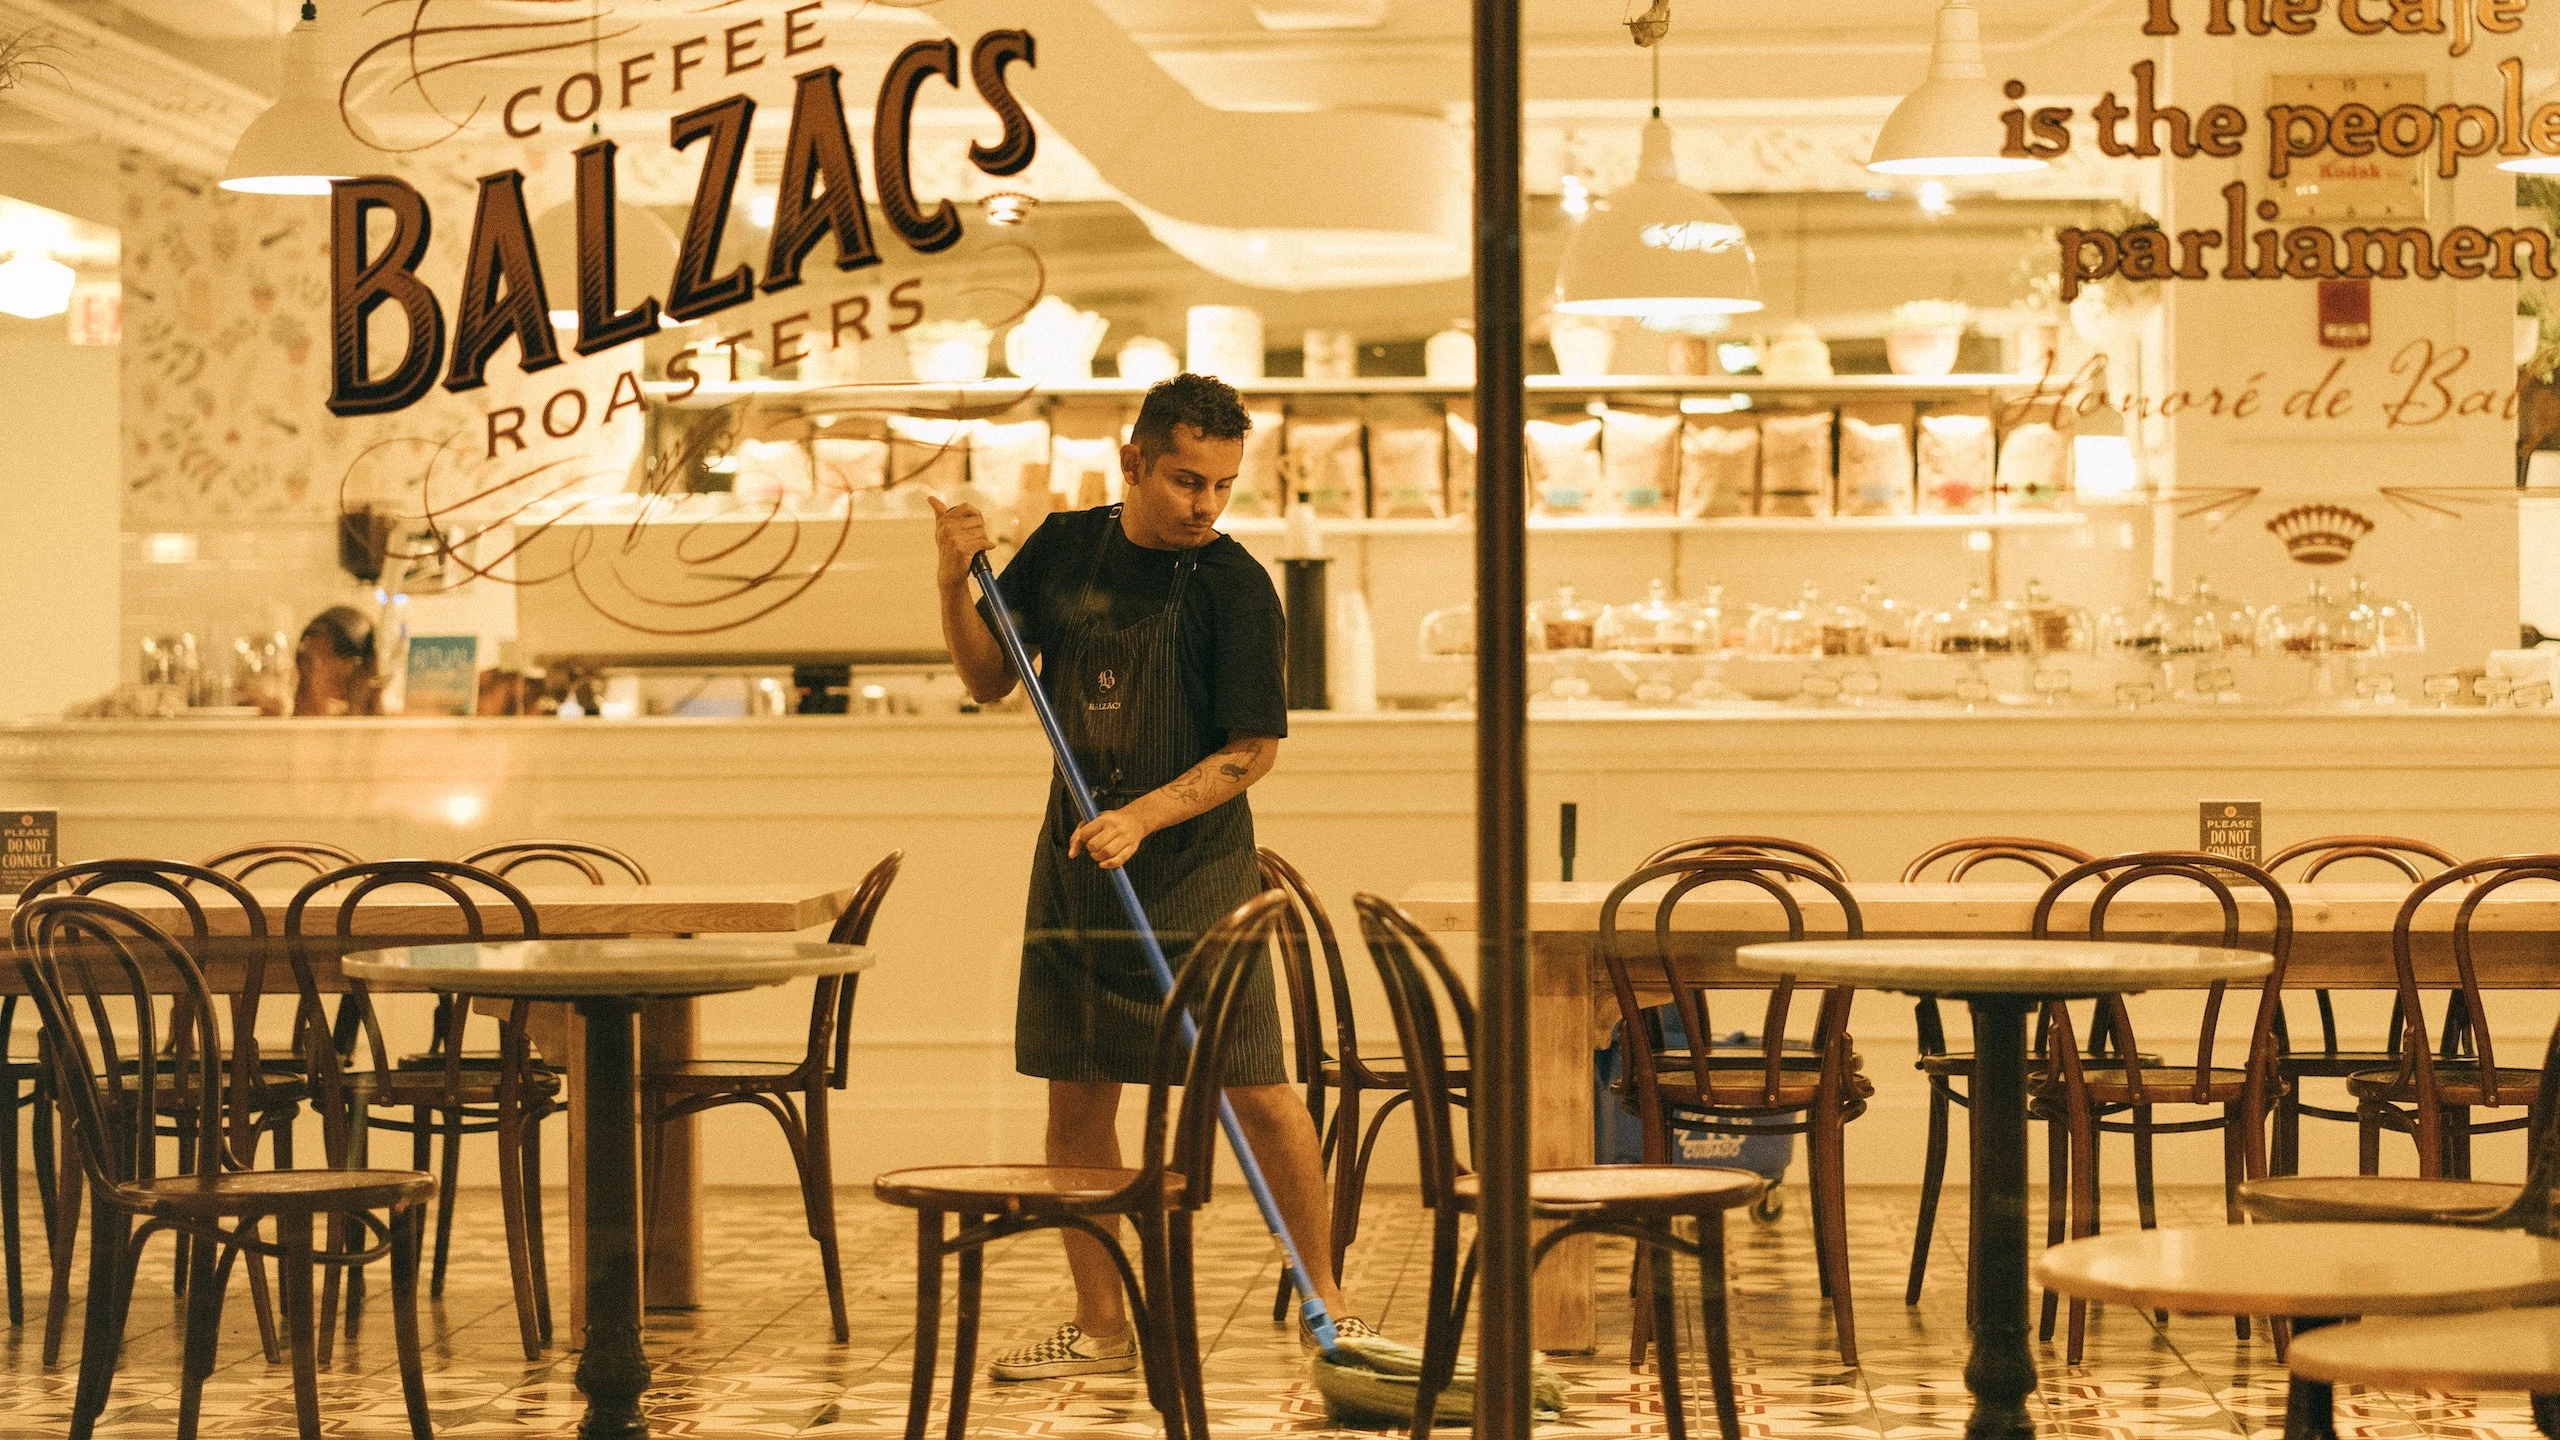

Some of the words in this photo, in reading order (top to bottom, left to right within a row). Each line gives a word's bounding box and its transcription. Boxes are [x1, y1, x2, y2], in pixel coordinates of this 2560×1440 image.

[503, 1, 828, 139] COFFEE
[2000, 80, 2073, 158] is
[2092, 60, 2247, 158] the
[2265, 57, 2560, 178] people
[2319, 163, 2381, 180] Kodak
[325, 29, 1037, 417] BALZACS
[2057, 180, 2557, 302] parliamen
[486, 279, 926, 459] ROASTERS
[2000, 348, 2267, 431] Honoré
[2283, 358, 2353, 420] de
[4, 828, 49, 838] PLEASE
[8, 838, 23, 852] DO
[25, 838, 47, 852] NOT
[2206, 820, 2254, 829] PLEASE
[2210, 829, 2226, 845] DO
[2228, 829, 2251, 845] NOT
[2, 853, 52, 869] CONNECT
